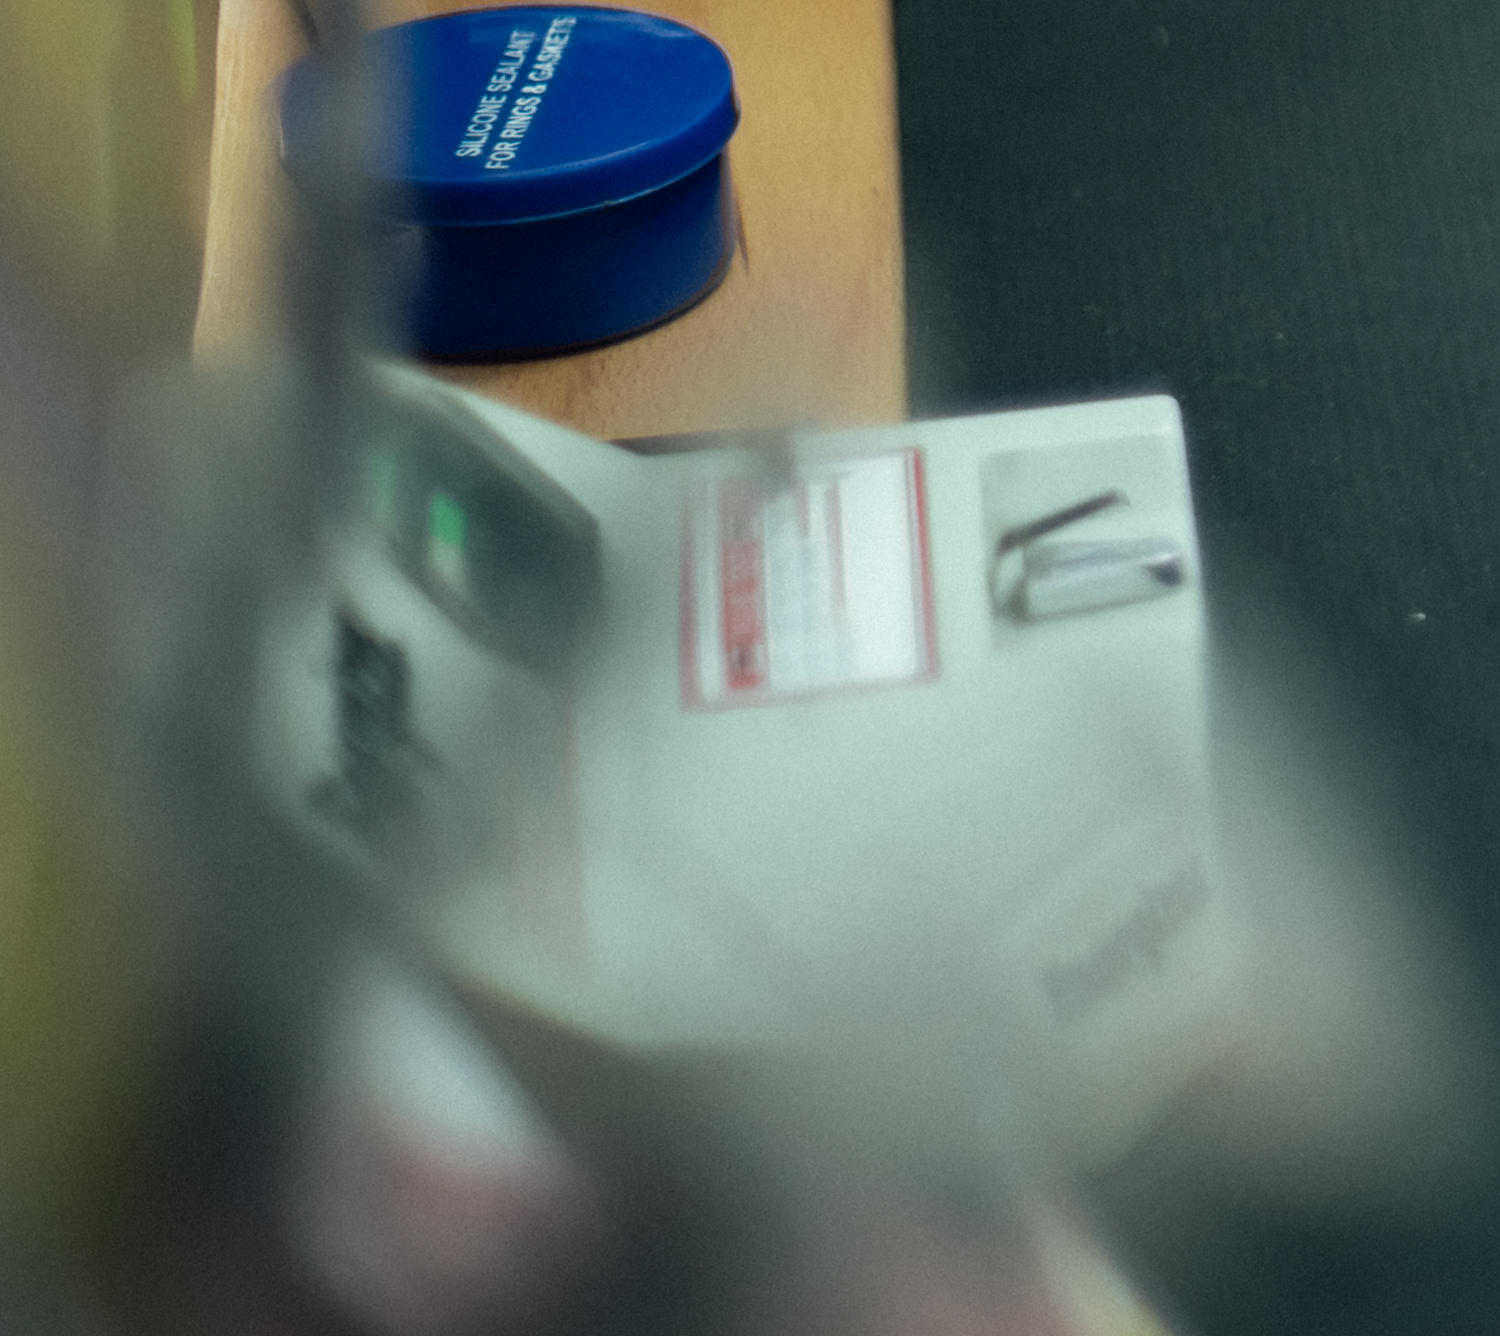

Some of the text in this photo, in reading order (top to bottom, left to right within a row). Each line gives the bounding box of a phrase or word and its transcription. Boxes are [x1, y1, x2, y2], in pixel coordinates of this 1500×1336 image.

[455, 29, 536, 158] SILICONE SEALANT
[485, 16, 577, 169] FOR RINGS & GASKETS
